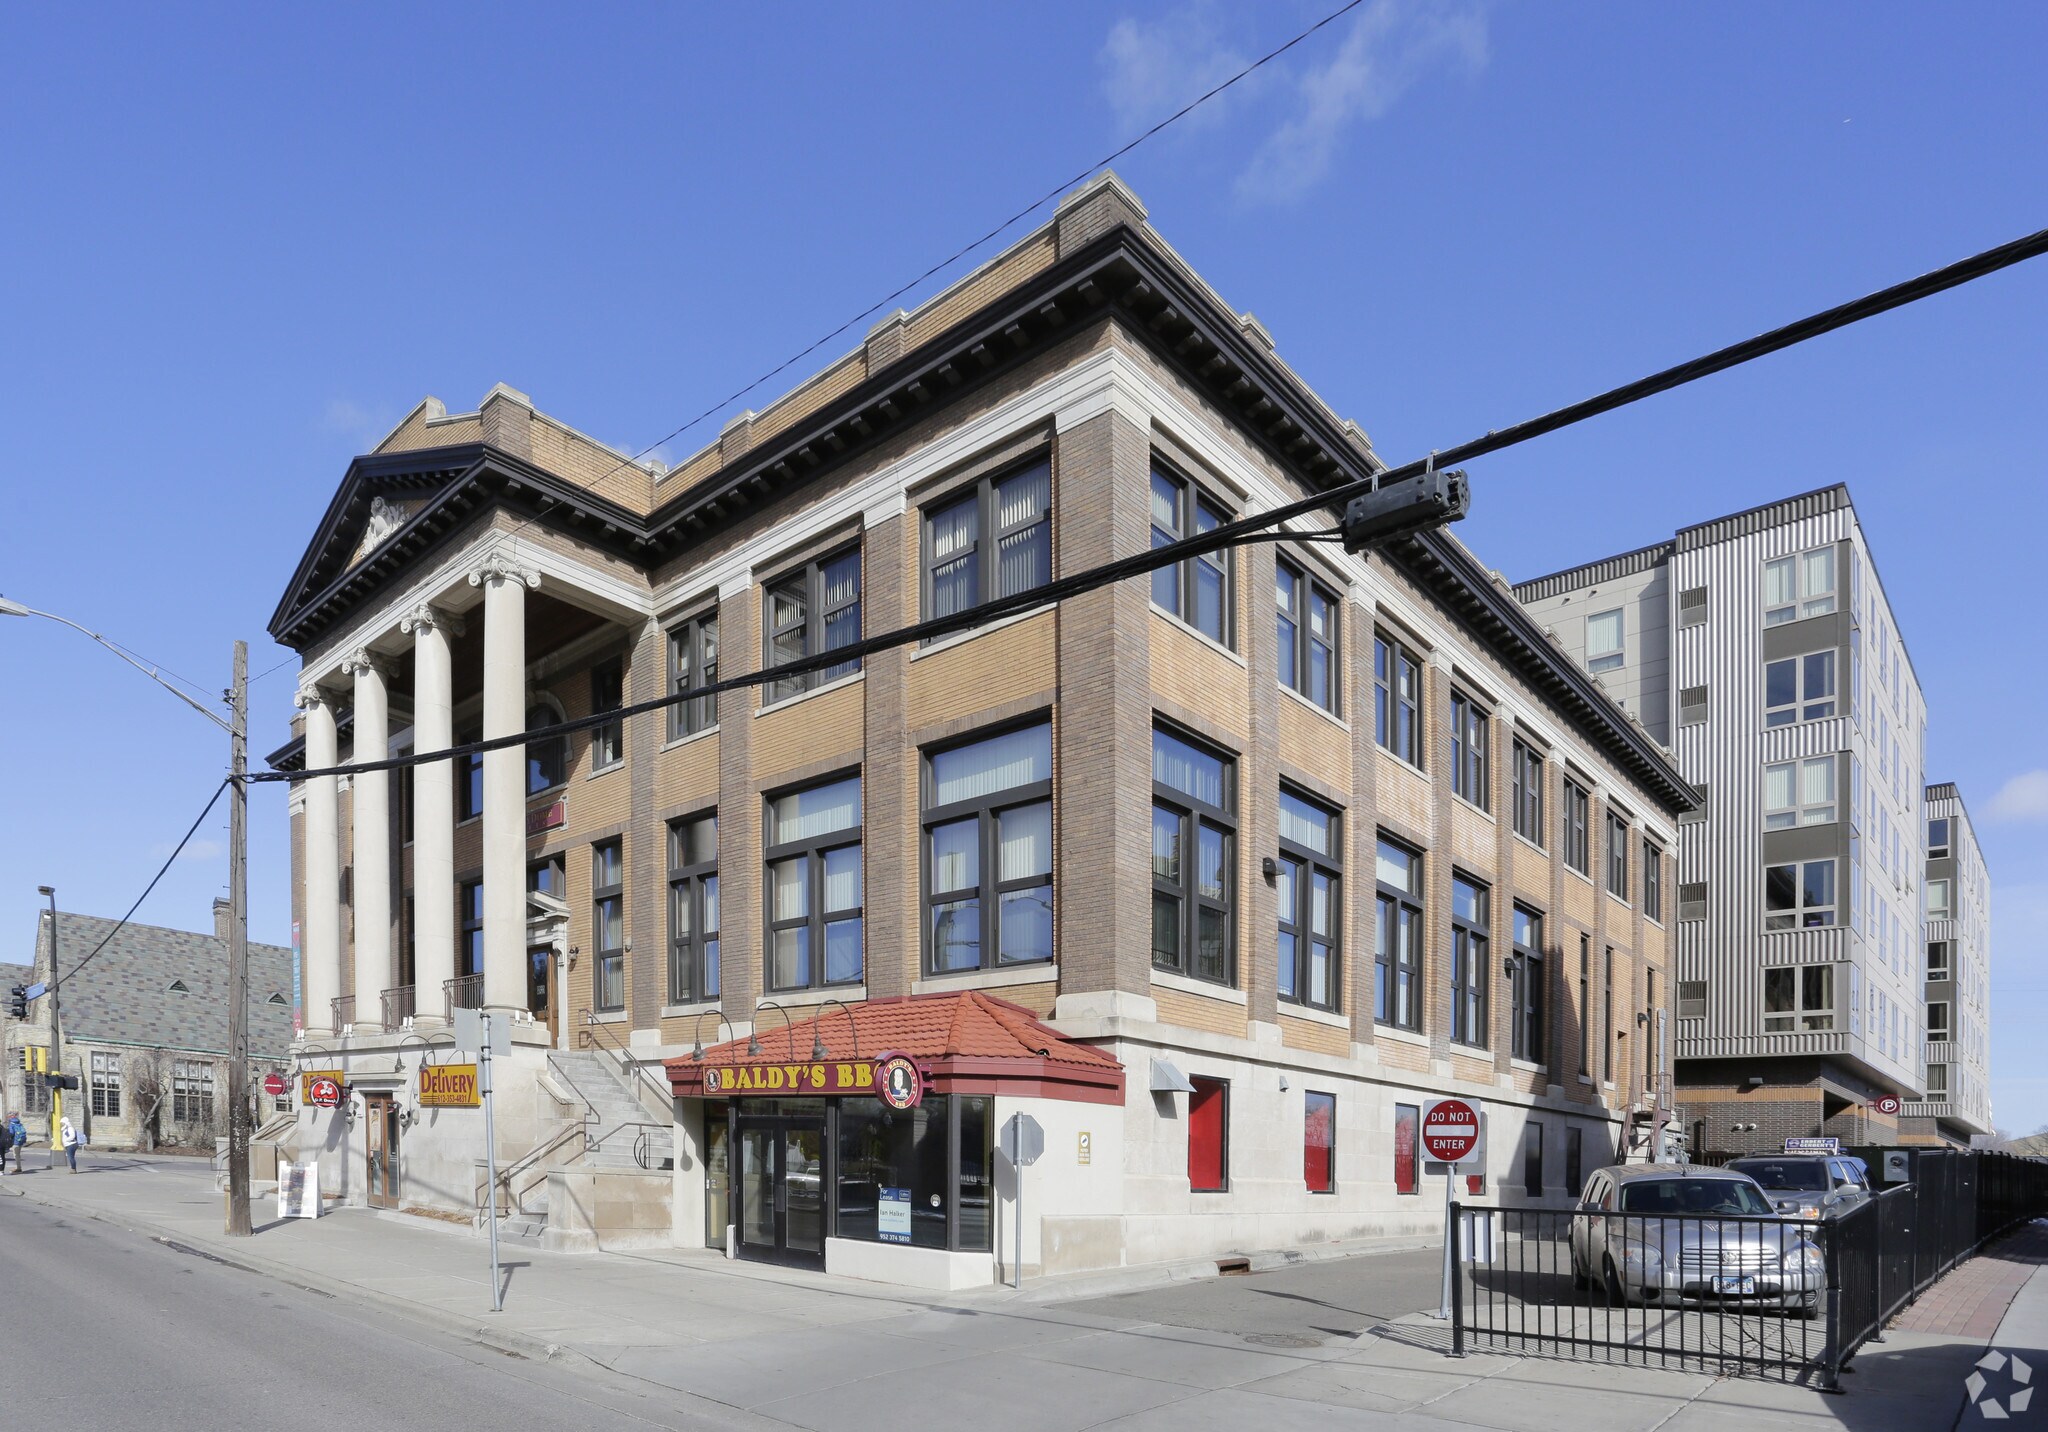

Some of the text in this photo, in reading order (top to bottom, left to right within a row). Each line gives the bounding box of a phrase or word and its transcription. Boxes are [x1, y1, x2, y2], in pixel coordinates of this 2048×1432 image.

[720, 1062, 882, 1089] BALDY'S BB
[1885, 1102, 1894, 1110] P
[1431, 1112, 1471, 1122] DO NOT
[1433, 1140, 1465, 1150] ENTER
